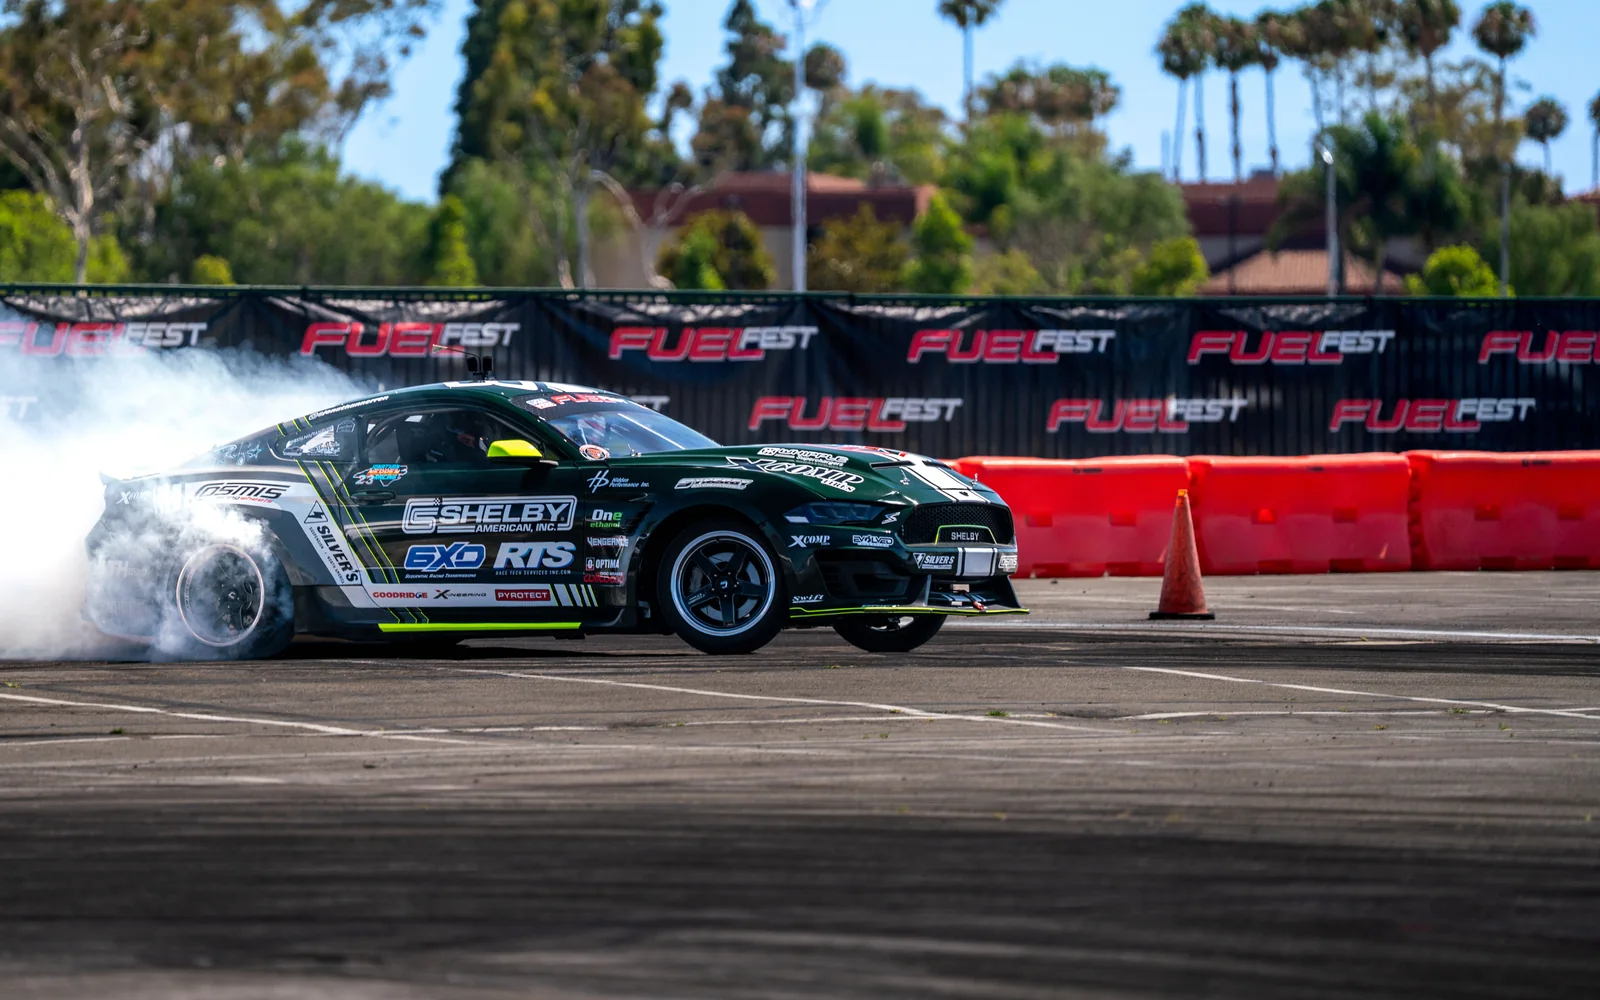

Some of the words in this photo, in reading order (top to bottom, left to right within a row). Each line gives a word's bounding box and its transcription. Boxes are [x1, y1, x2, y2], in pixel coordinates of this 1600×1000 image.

[300, 322, 520, 357] FUELFEST
[607, 326, 818, 361] FUELFEST
[907, 329, 1115, 363] FUELFEST
[1187, 331, 1395, 364] FUELFEST
[1478, 330, 1600, 364] FUE
[748, 396, 963, 432] FUELFEST
[1045, 398, 1248, 433] FUELFEST
[1328, 398, 1535, 432] FUELFEST
[355, 475, 374, 485] 23
[439, 503, 569, 525] SHELBY
[475, 523, 533, 534] AMERICAN,
[535, 522, 557, 533] INC.
[592, 509, 623, 521] One
[951, 532, 979, 541] SHELBY
[317, 525, 360, 582] SILVER'S
[493, 542, 577, 569] RTS
[595, 559, 620, 569] OPTIMA
[373, 591, 428, 599] GOODRIDGE
[497, 591, 548, 599] PYROTECT
